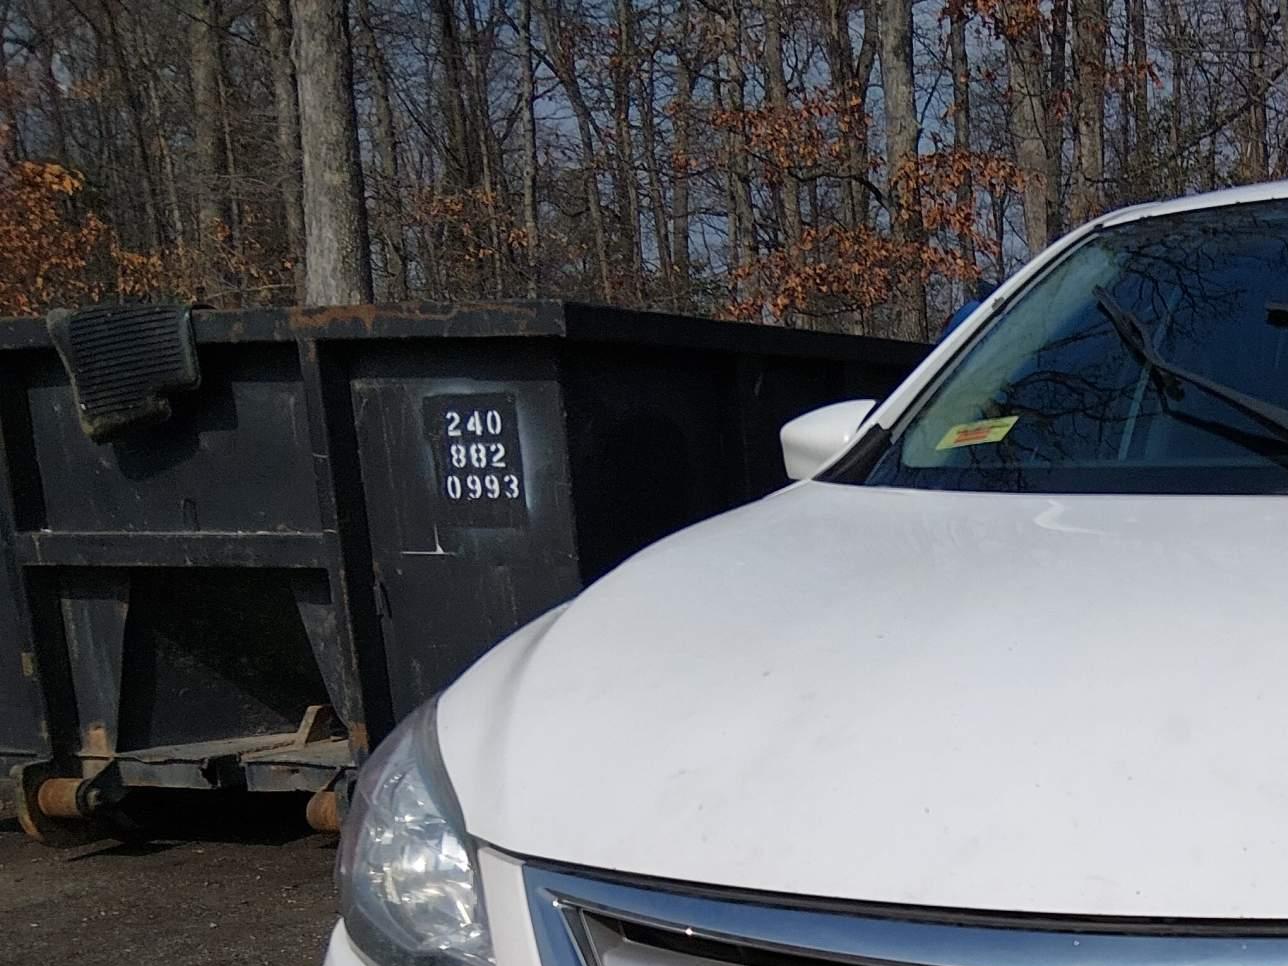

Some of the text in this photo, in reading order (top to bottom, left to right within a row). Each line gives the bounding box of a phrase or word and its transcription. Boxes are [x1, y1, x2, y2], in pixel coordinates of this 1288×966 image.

[446, 410, 502, 437] 240
[450, 443, 507, 468] 882
[447, 474, 520, 499] 0993
